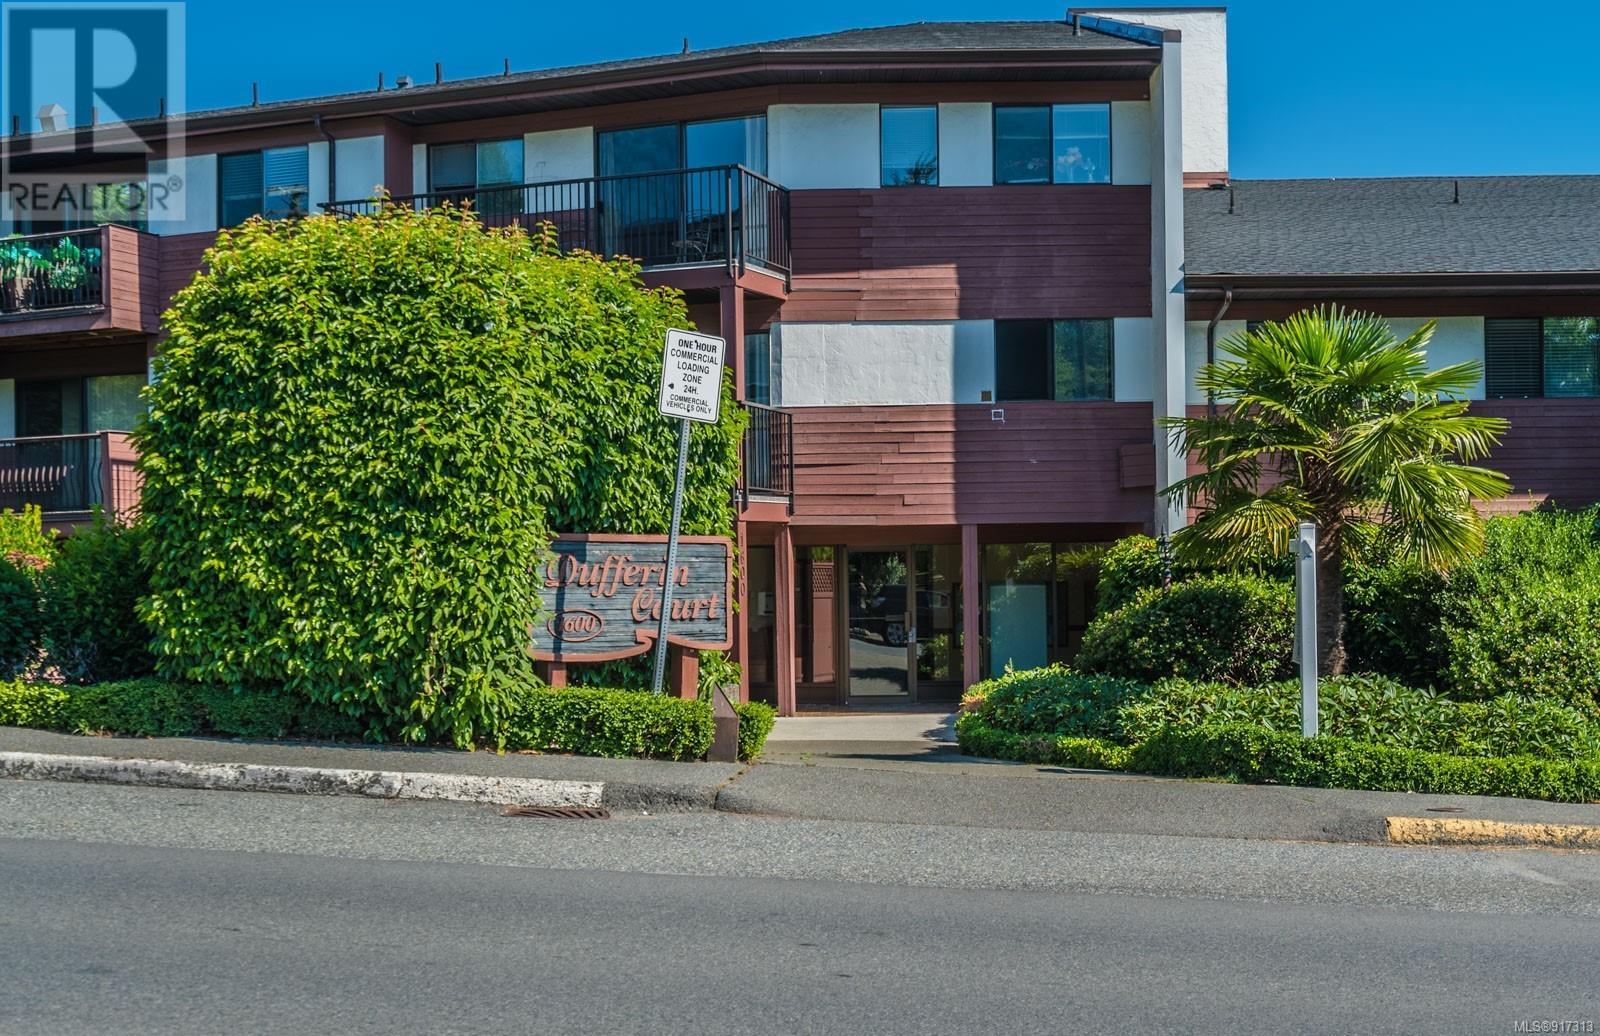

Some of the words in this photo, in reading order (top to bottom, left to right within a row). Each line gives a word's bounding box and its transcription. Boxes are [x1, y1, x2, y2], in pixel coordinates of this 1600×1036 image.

[678, 339, 693, 349] ONE
[696, 342, 717, 354] HOUR
[670, 348, 718, 365] COMMERCIAL
[677, 361, 710, 374] LOADING
[682, 373, 702, 384] ZONE
[683, 385, 699, 395] 24H.
[666, 400, 695, 411] VEHICLES
[695, 406, 712, 414] ONLY
[669, 394, 709, 407] COMMERCIAL
[544, 553, 689, 597] Dufferin
